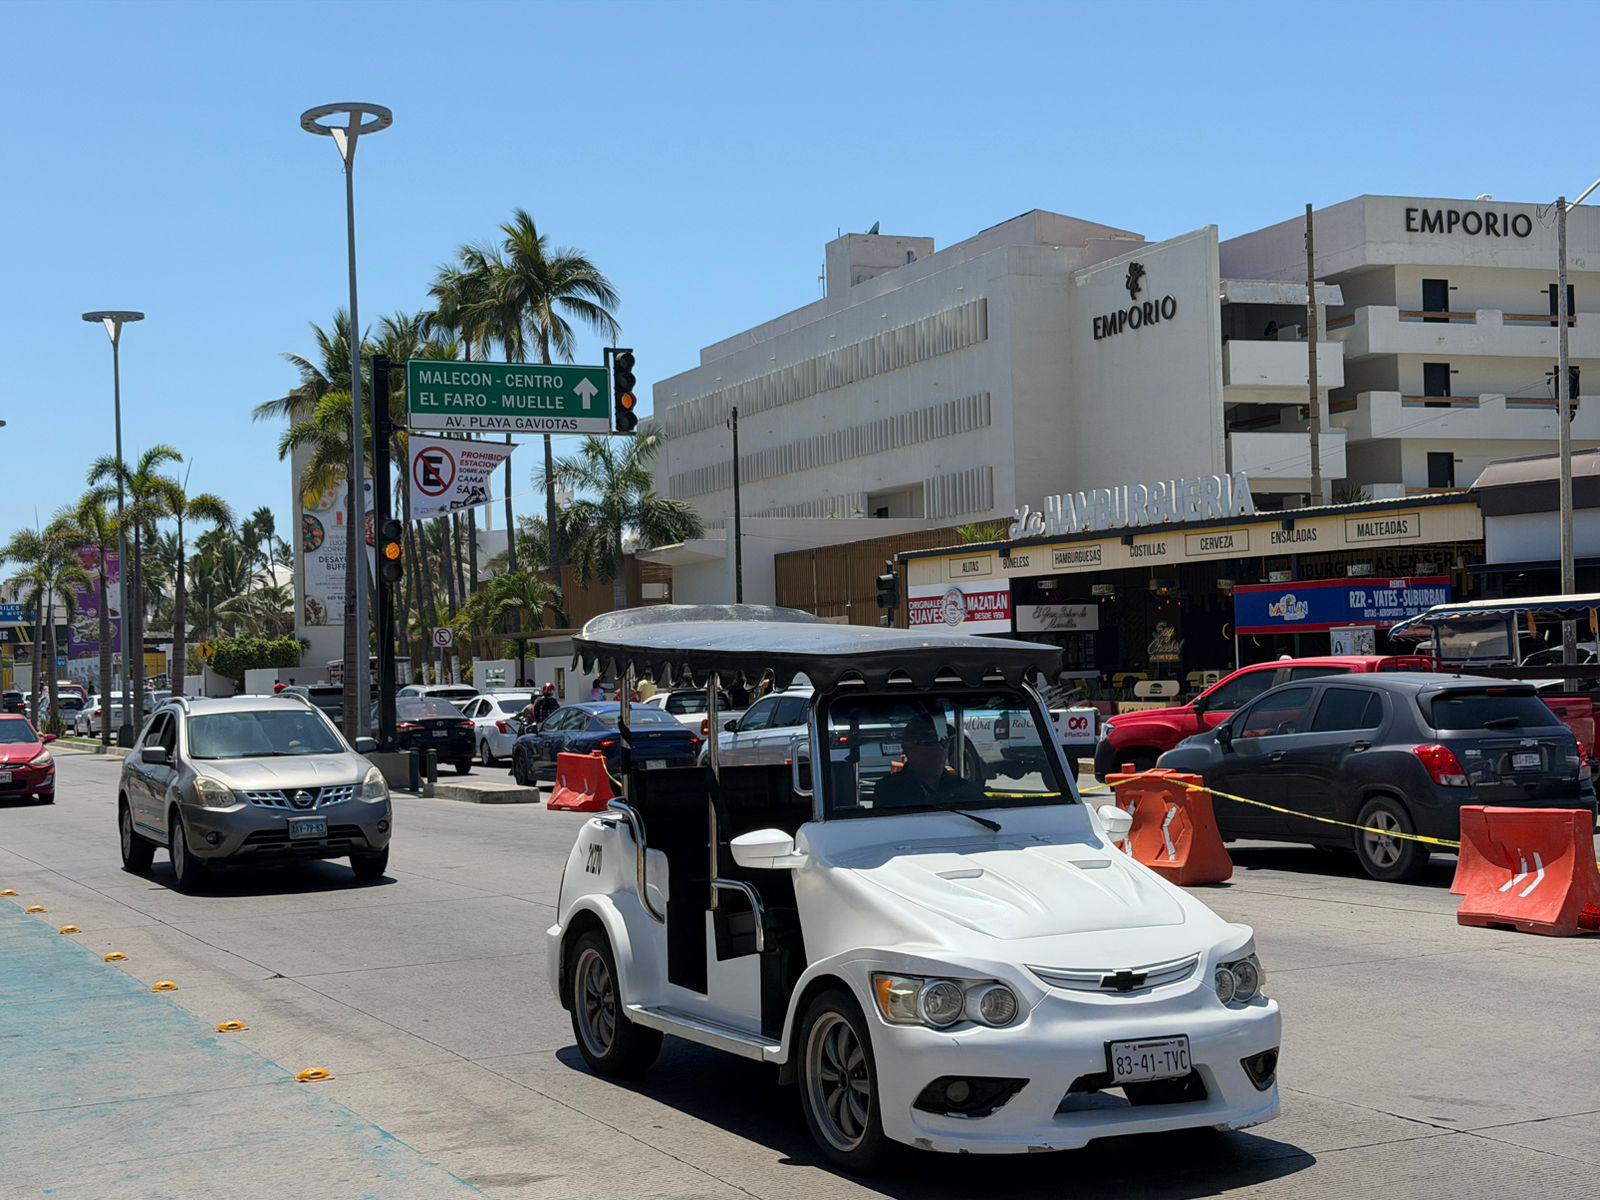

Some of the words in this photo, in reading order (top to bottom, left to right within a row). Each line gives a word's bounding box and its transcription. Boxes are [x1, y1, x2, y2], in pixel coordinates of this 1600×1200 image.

[1405, 208, 1533, 238] EMPORIO
[1092, 294, 1176, 340] EMPORIO
[419, 370, 492, 386] MALECON
[505, 374, 563, 389] CENTRO
[420, 392, 439, 406] EL
[444, 393, 487, 407] FARO
[501, 395, 564, 409] MUELLE
[445, 416, 465, 428] AV.
[470, 417, 511, 429] PLAYA
[515, 418, 578, 430] GAVIOTAS
[1044, 471, 1256, 537] HAMBURGUERIA
[1271, 528, 1317, 544] ENSALADAS
[1357, 520, 1408, 538] MALTEADAS
[1130, 543, 1166, 558] COSTILLAS
[1200, 535, 1234, 551] CERVEZA
[1002, 556, 1030, 569] BONELESS
[1055, 549, 1101, 565] HAMBURGUESAS
[962, 561, 979, 573] ALITAS
[908, 600, 945, 610] ORIGINALES
[967, 593, 1008, 610] MAZATLÁN
[1349, 590, 1366, 608] RZR
[1373, 590, 1398, 607] YATES
[909, 608, 945, 624] SUAVES
[975, 612, 992, 620] DESDE
[1116, 1050, 1188, 1076] 83-41-TVC
